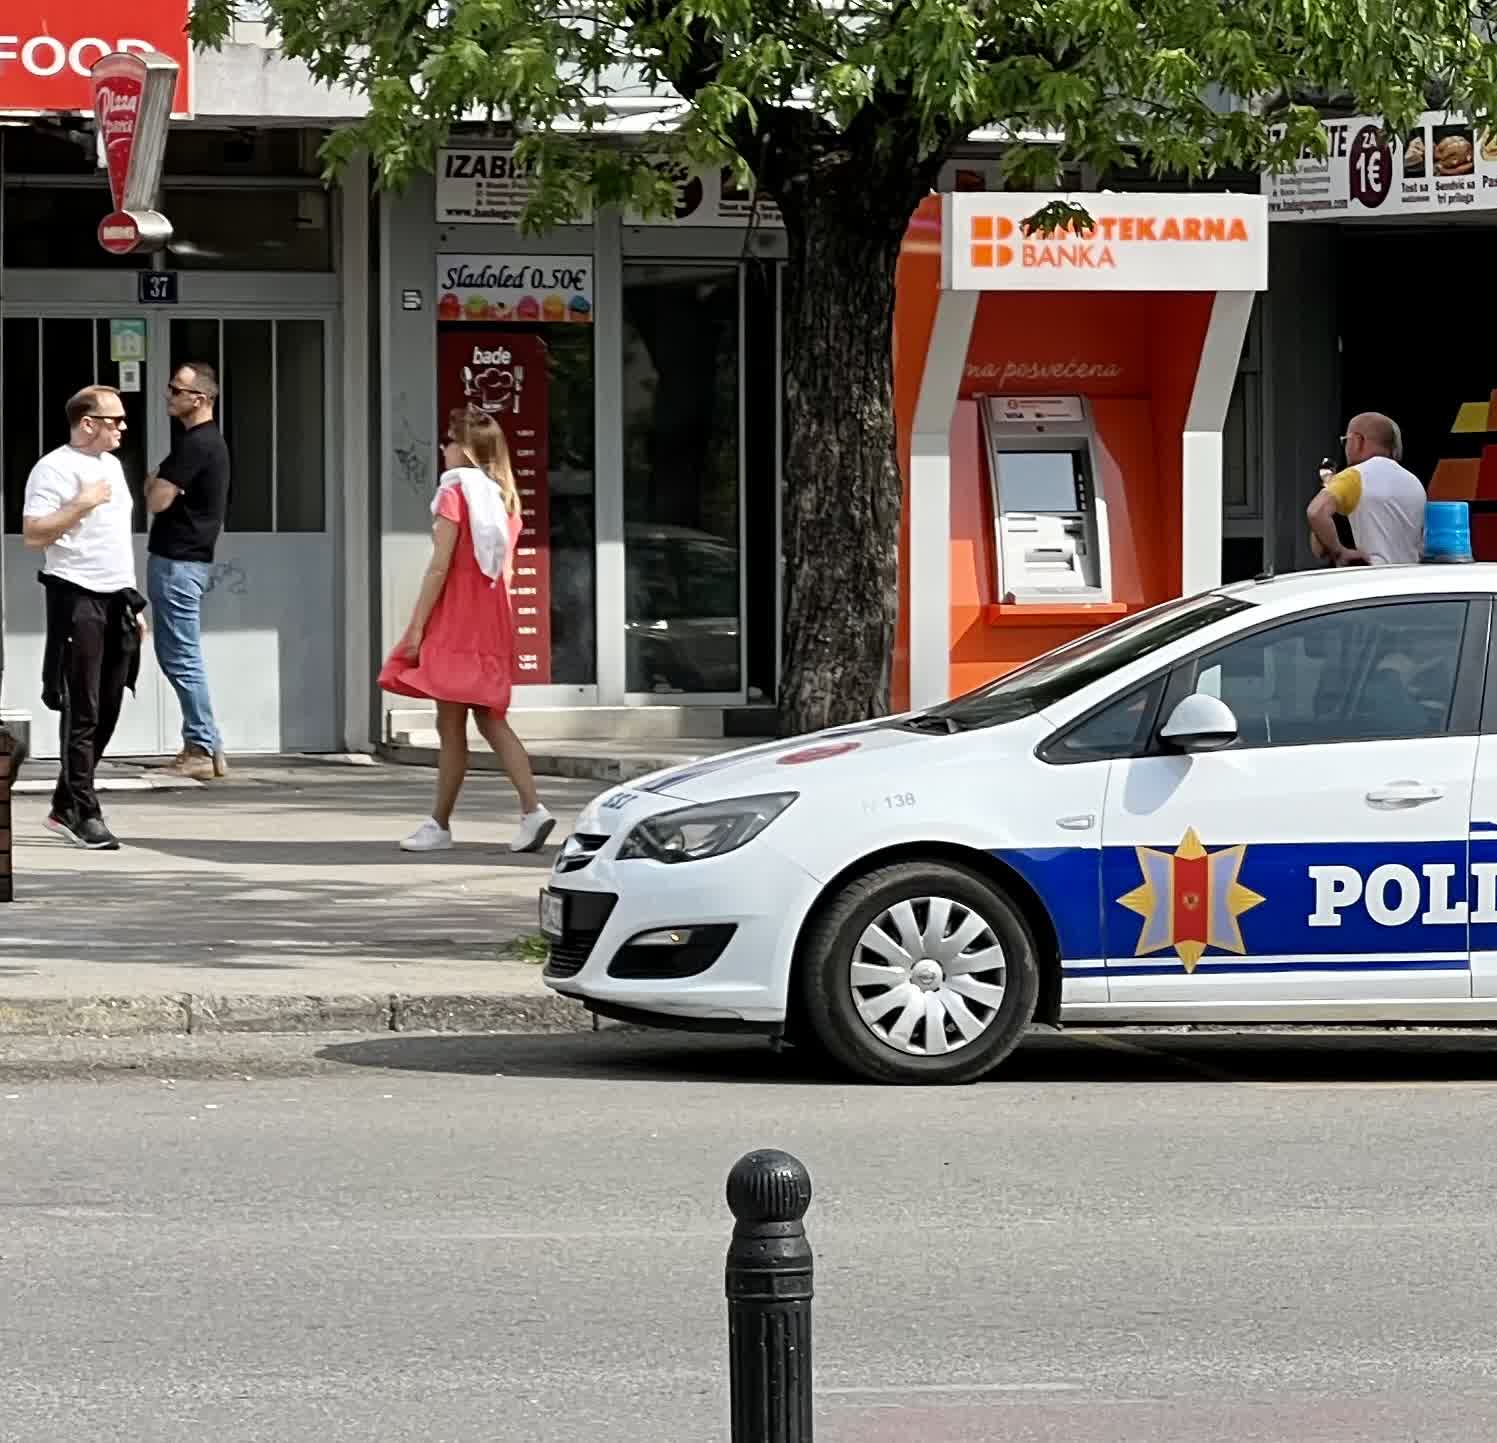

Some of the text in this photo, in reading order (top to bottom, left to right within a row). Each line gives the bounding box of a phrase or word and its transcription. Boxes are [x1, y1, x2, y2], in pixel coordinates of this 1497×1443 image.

[1356, 151, 1382, 193] 1€
[1021, 217, 1249, 241] TEKARNA
[1021, 246, 1117, 268] BANKA
[149, 277, 169, 298] 37
[441, 264, 587, 291] Sladoled 0.50€
[472, 346, 512, 365] bade
[884, 792, 916, 809] 138
